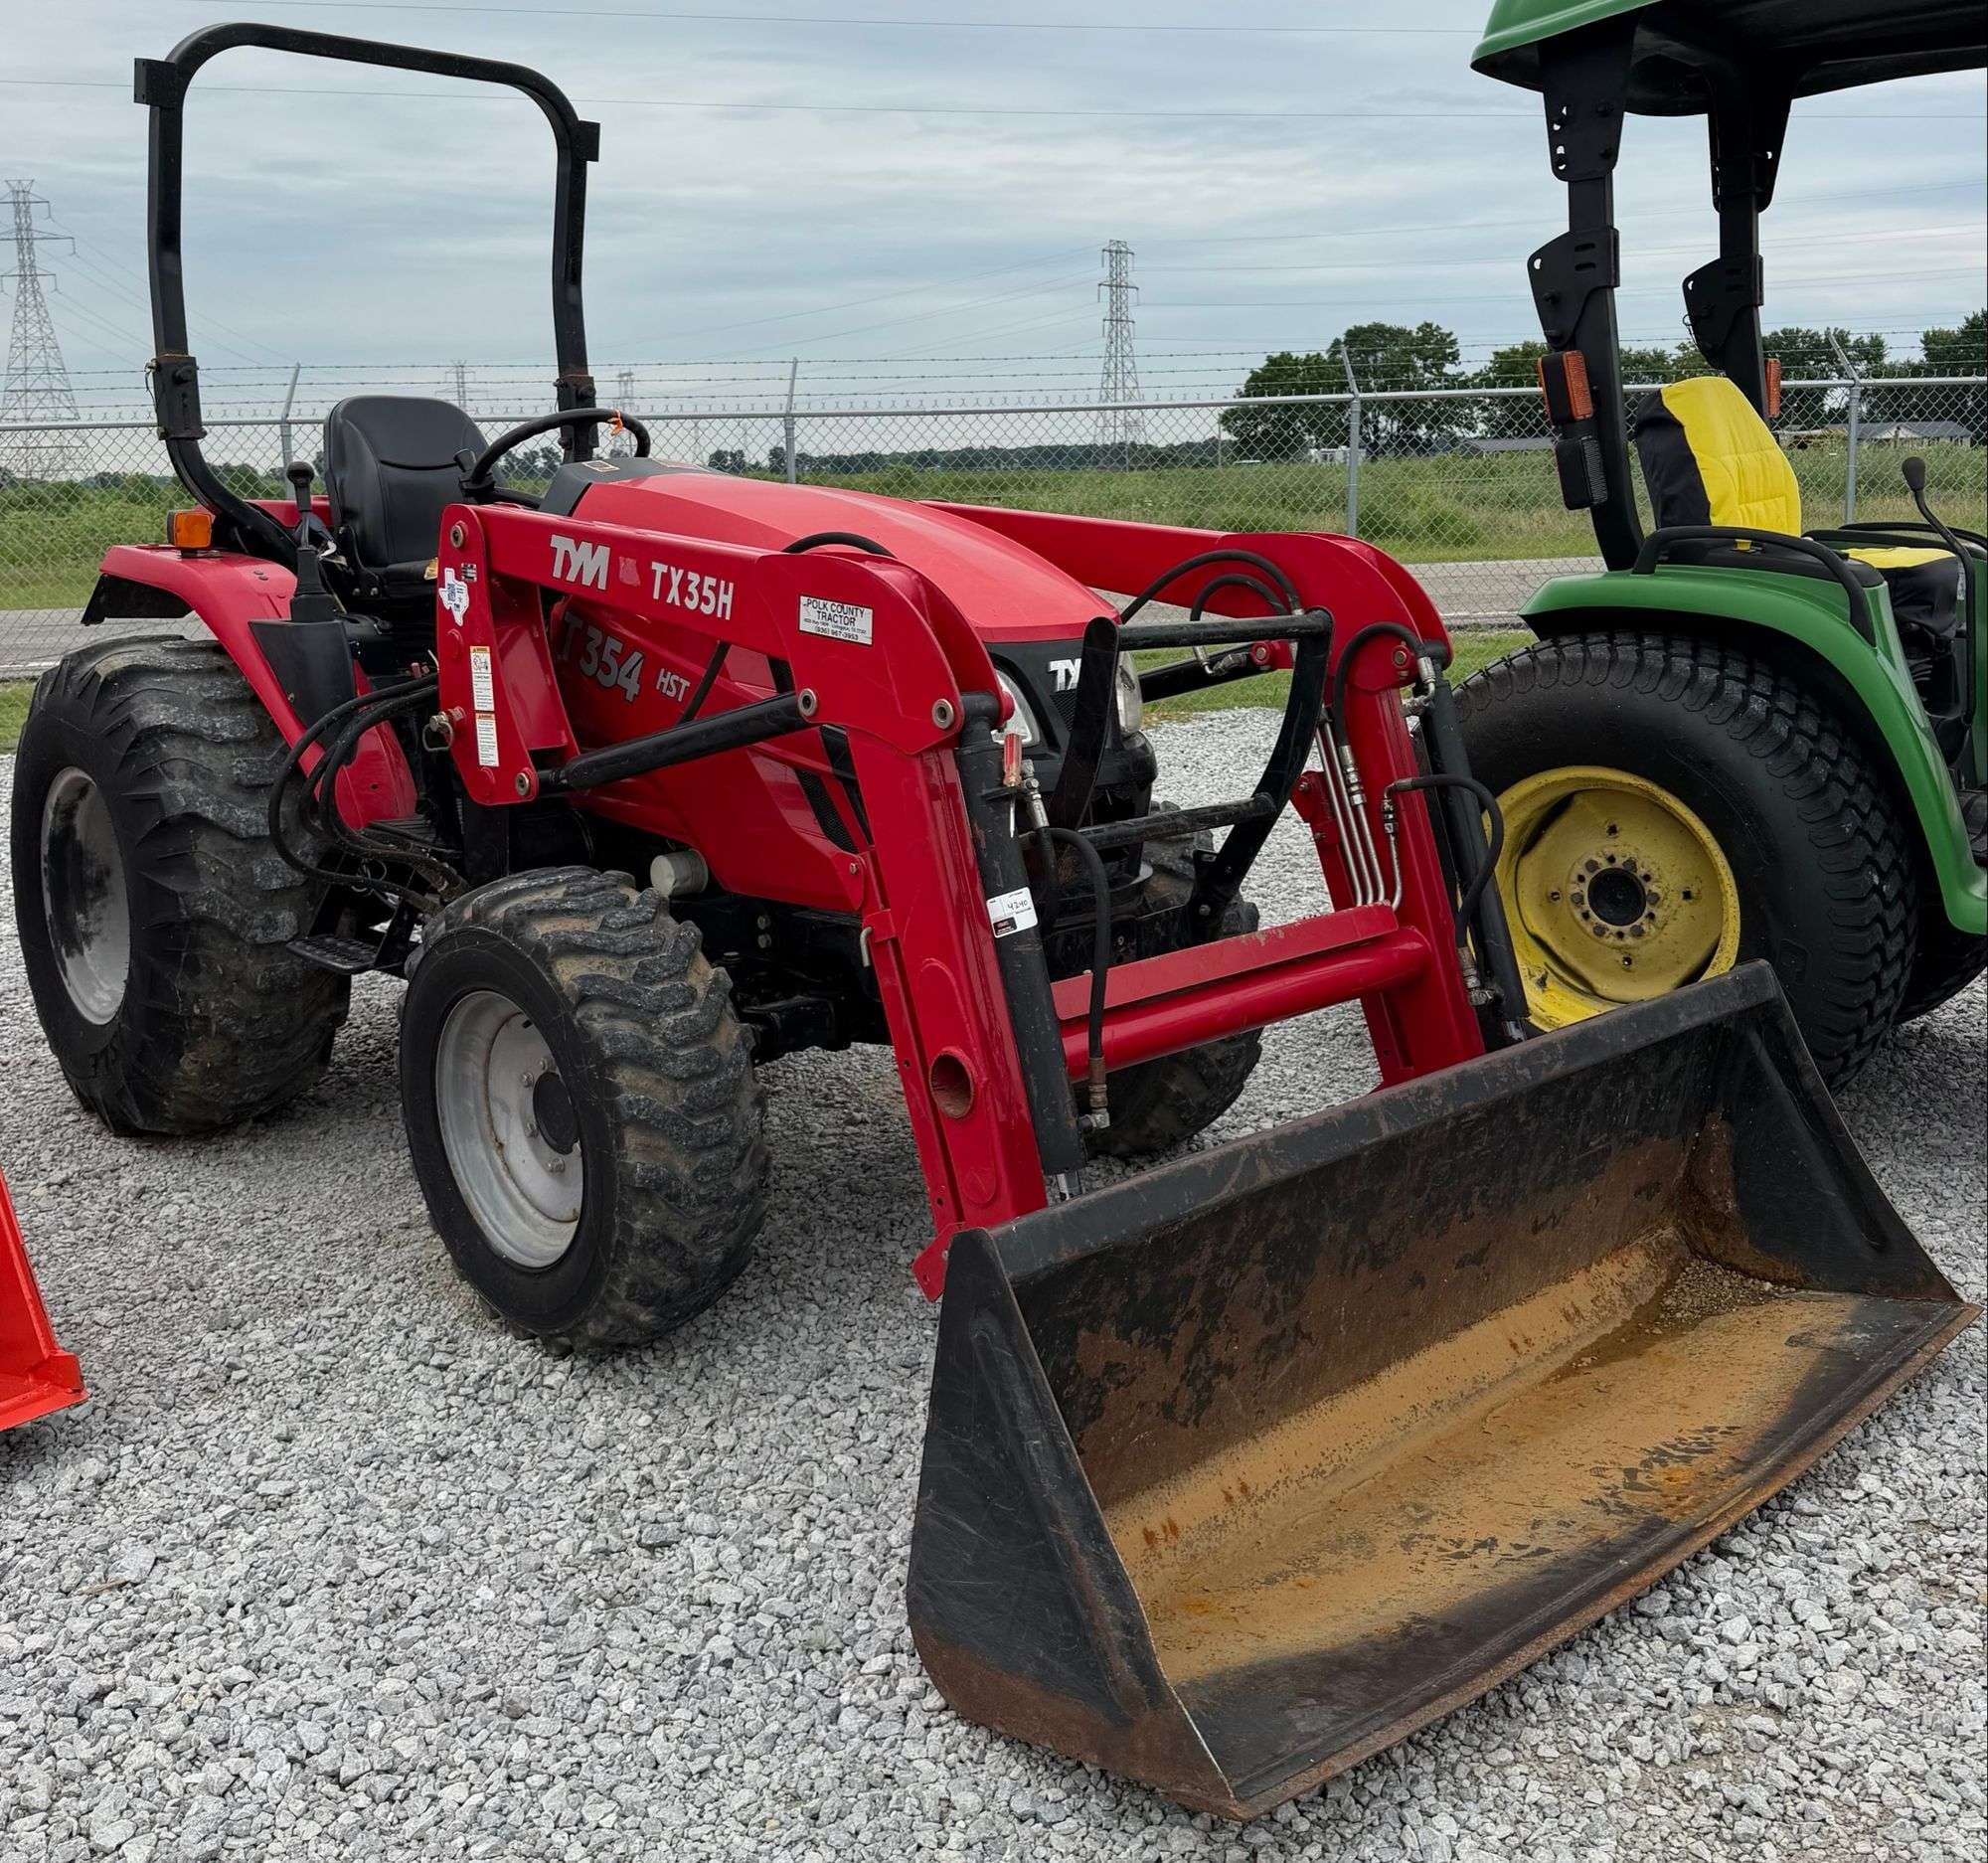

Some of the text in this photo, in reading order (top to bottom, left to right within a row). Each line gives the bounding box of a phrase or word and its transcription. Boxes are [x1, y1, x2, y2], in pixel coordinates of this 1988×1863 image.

[550, 534, 735, 621] TYM TX35H
[806, 598, 865, 618] POLK COUNTY
[816, 610, 857, 626] TRACTOR
[656, 667, 692, 703] HST
[1048, 657, 1082, 693] TY
[1007, 899, 1028, 911] 4240
